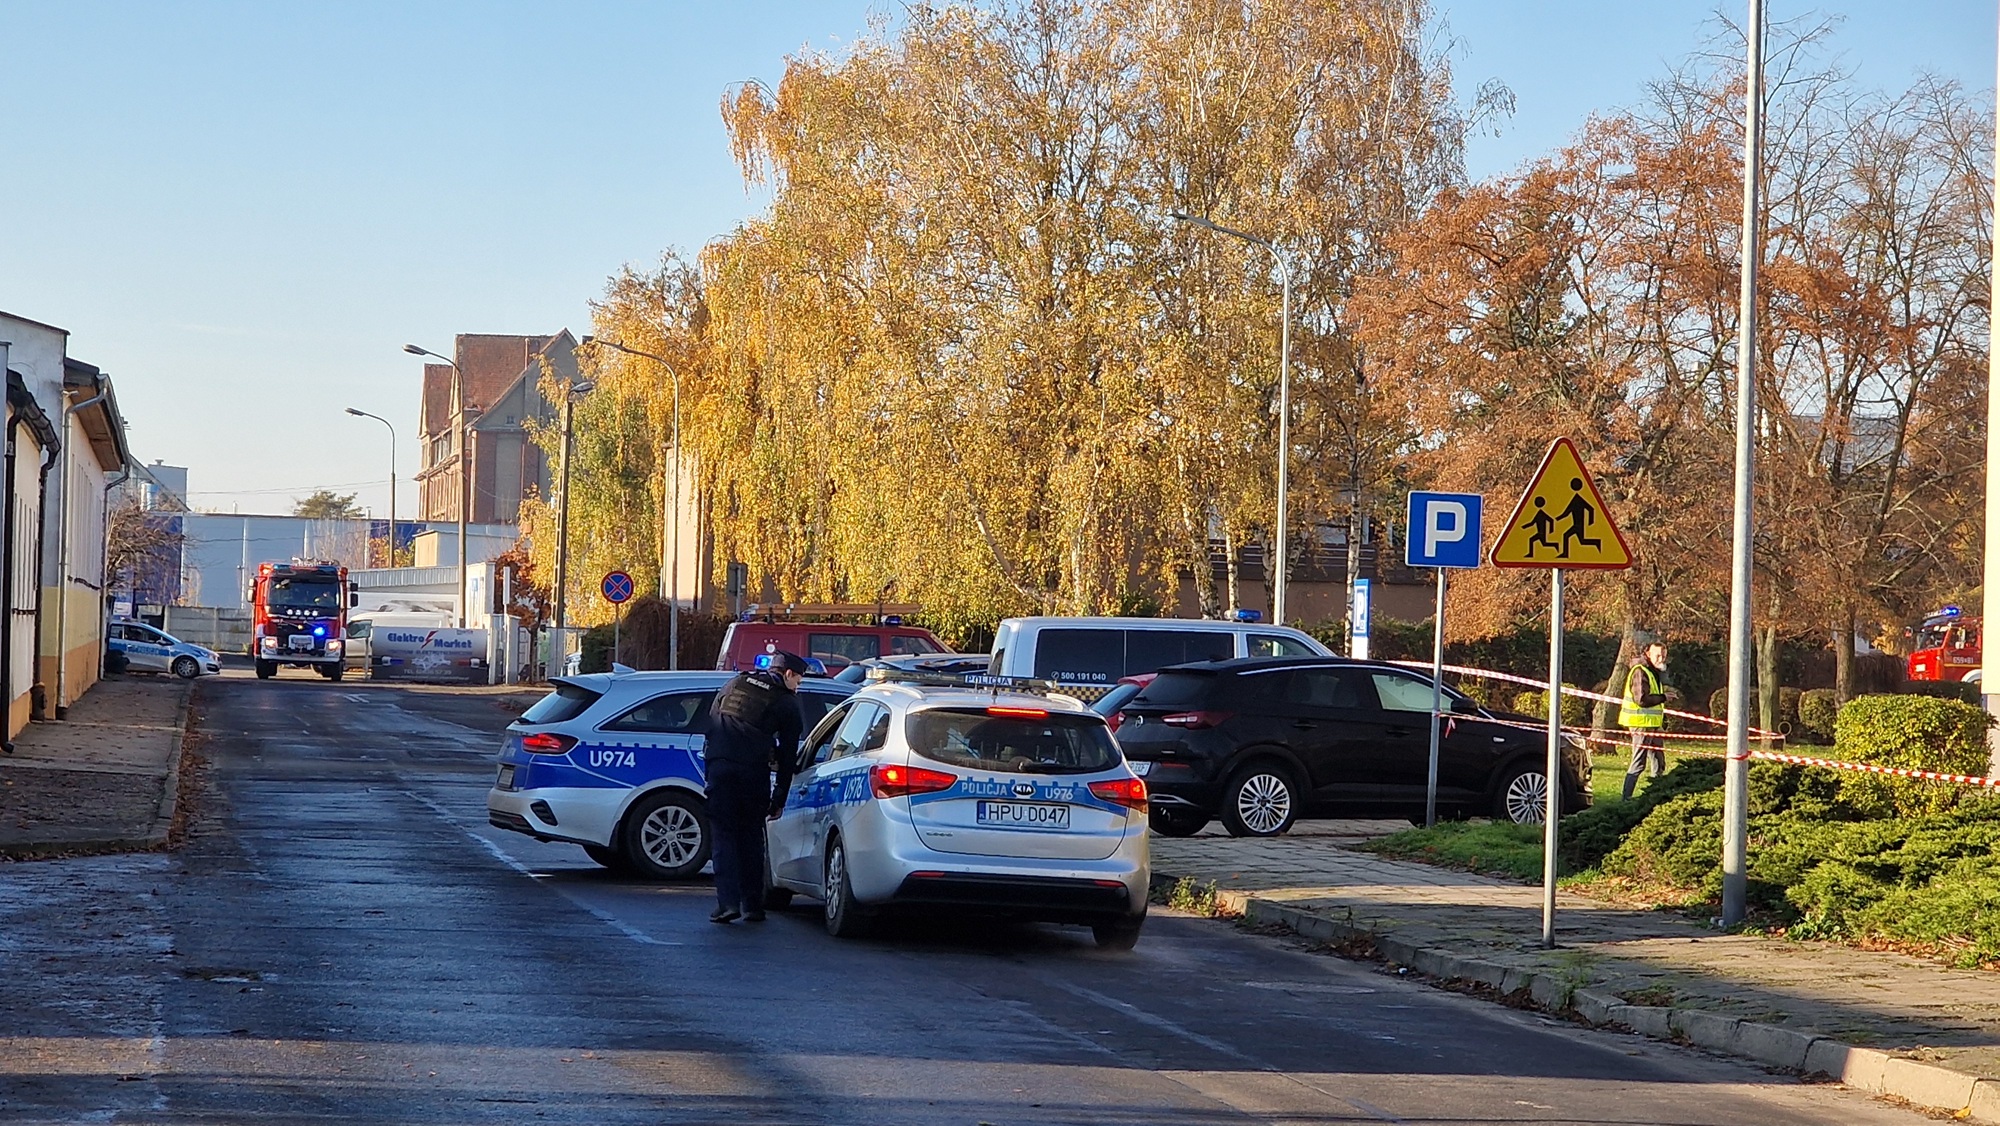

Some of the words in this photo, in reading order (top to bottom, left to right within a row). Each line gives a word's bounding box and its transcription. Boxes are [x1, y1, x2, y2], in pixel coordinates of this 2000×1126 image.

[1424, 500, 1467, 558] P
[387, 633, 424, 643] Elektro
[434, 639, 472, 649] Market
[967, 675, 1010, 686] POLICJA
[1061, 671, 1075, 680] 500
[1077, 672, 1090, 680] 191
[1092, 673, 1107, 681] 040
[746, 677, 770, 690] POLICJA
[589, 750, 636, 768] U974
[843, 776, 866, 799] U976
[961, 782, 1008, 796] POLICJA
[1044, 786, 1074, 800] U976
[988, 804, 1023, 821] HPU
[1028, 807, 1067, 824] D047
